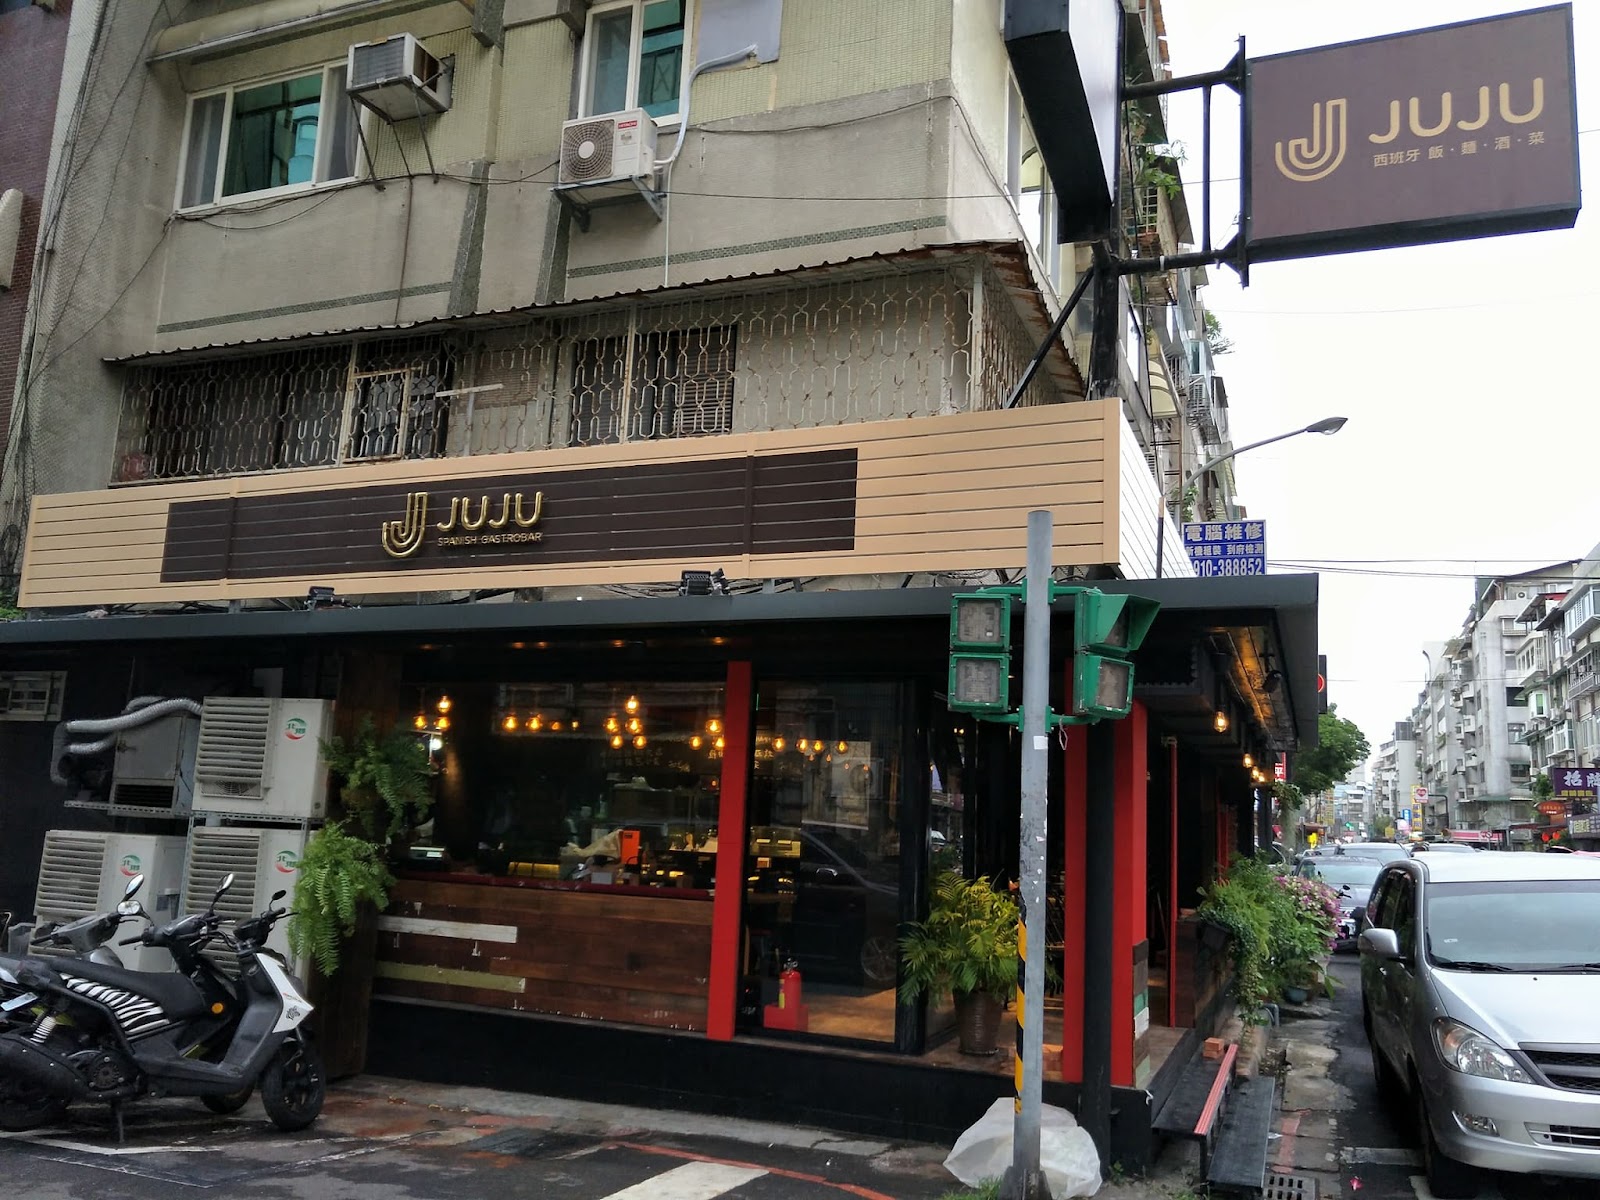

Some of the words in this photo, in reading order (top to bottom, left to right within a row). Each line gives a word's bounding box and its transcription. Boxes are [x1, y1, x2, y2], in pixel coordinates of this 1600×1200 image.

[1368, 76, 1544, 144] JUJU
[1373, 149, 1421, 168] 西班牙
[436, 491, 544, 532] JUJU
[437, 535, 477, 547] SPANISH
[481, 531, 543, 544] GASTROBAR
[1185, 522, 1263, 542] 電腦維修
